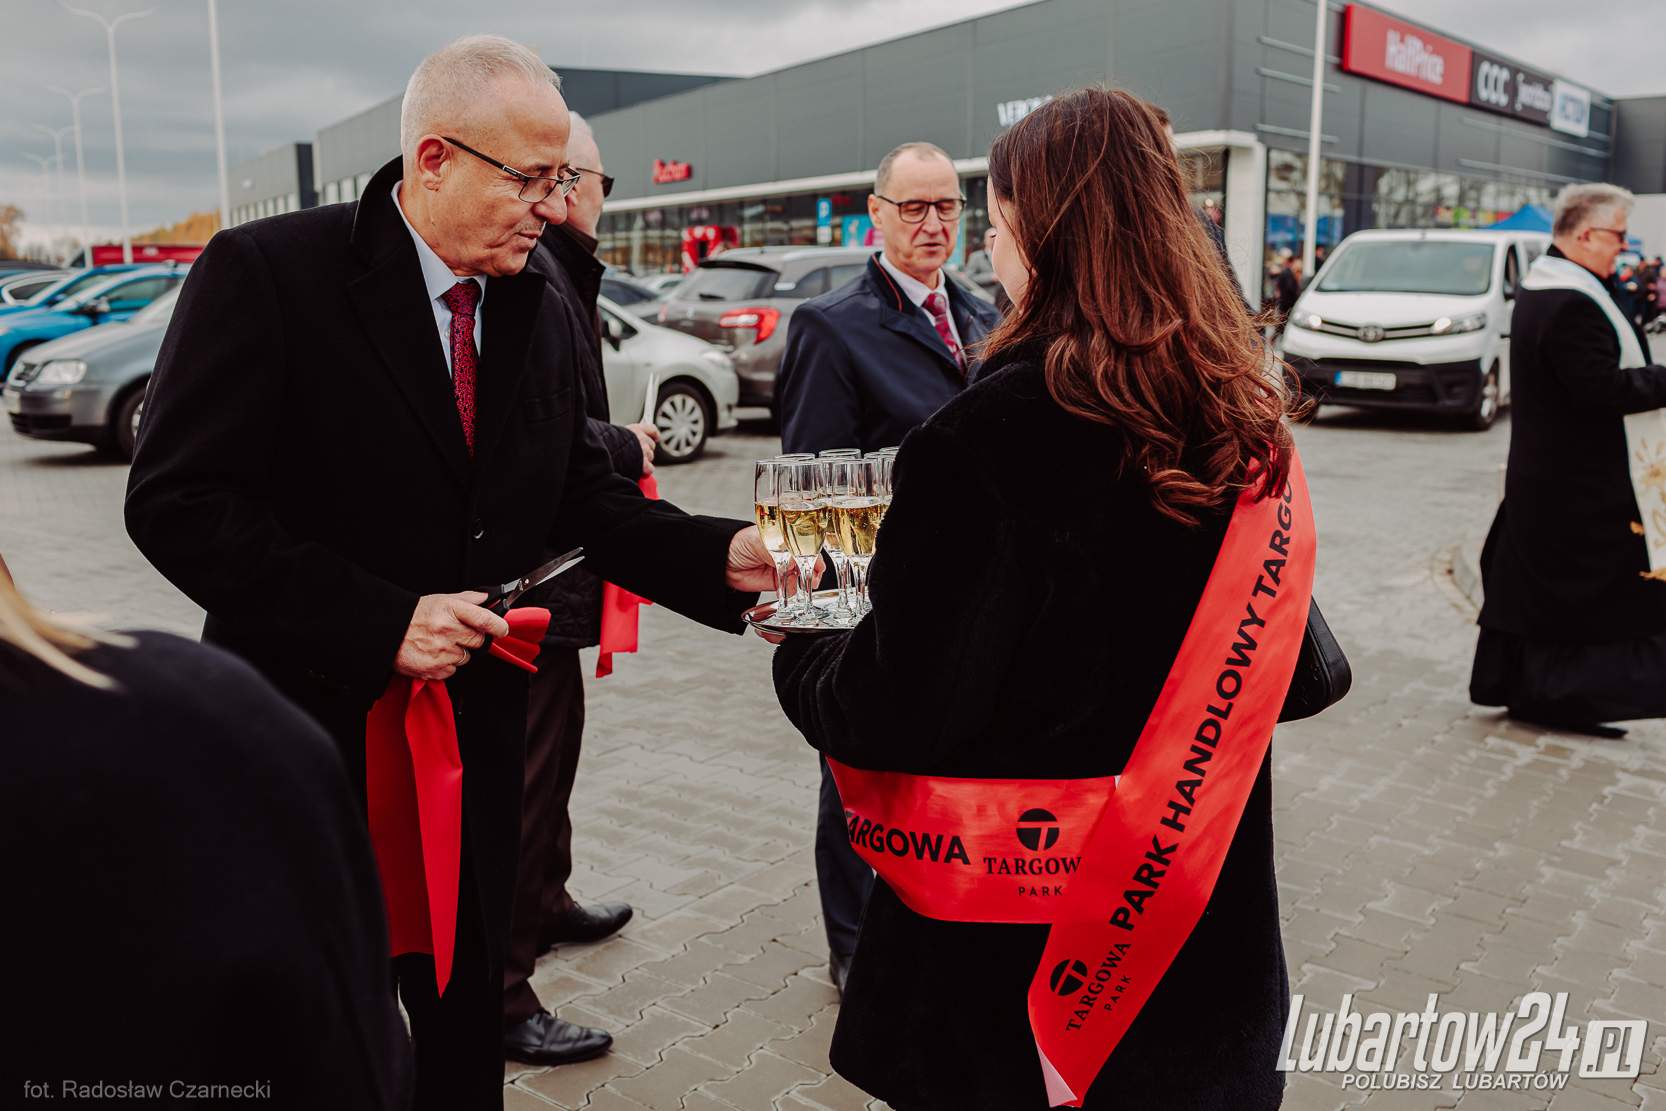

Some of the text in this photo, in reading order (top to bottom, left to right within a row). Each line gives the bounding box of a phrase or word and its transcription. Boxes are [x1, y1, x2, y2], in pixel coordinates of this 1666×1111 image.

[1477, 60, 1510, 107] CCC
[1110, 835, 1178, 931] PARK
[1160, 602, 1267, 834] HANDLOWY
[1018, 885, 1064, 897] PARK
[1066, 942, 1132, 1032] TARGOWA
[1104, 975, 1132, 1011] PARK
